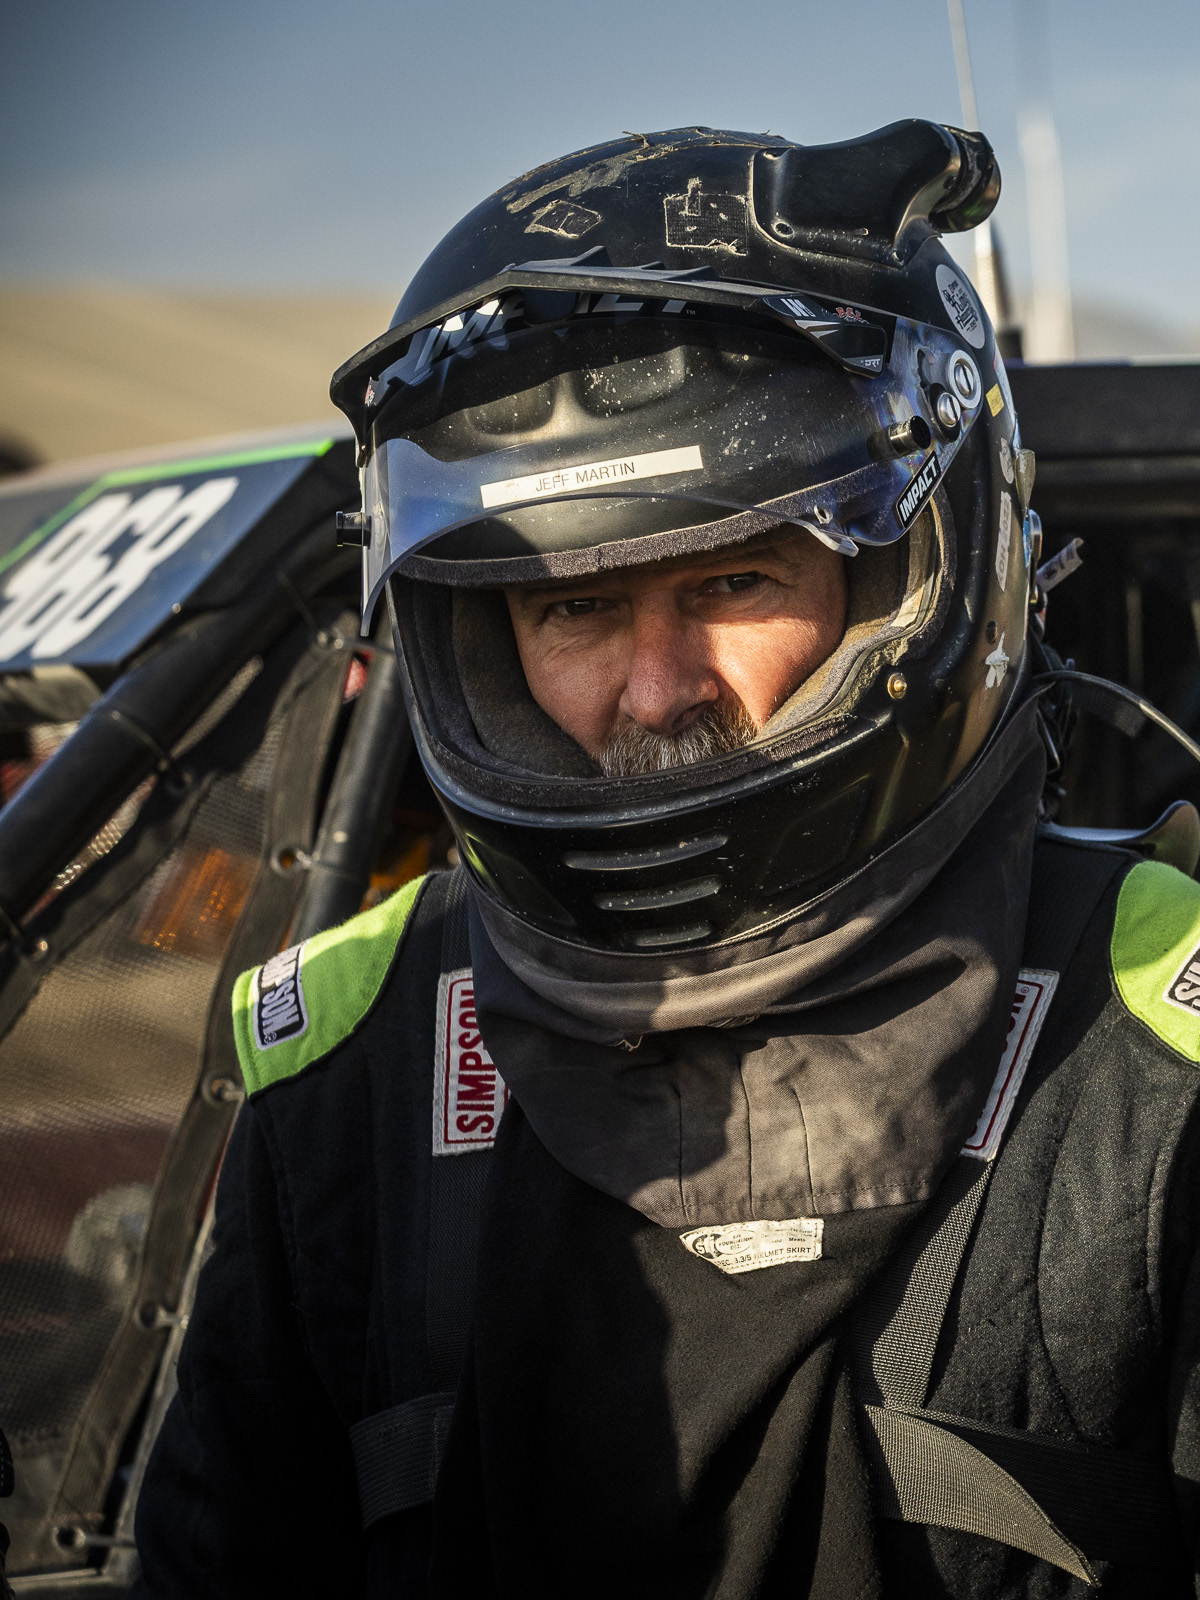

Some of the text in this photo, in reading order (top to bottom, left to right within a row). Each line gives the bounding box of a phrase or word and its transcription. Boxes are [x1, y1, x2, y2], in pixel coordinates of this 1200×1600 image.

[535, 461, 636, 493] JEFF MARTIN
[899, 455, 938, 522] IMPACT
[786, 1246, 812, 1254] SKIRT
